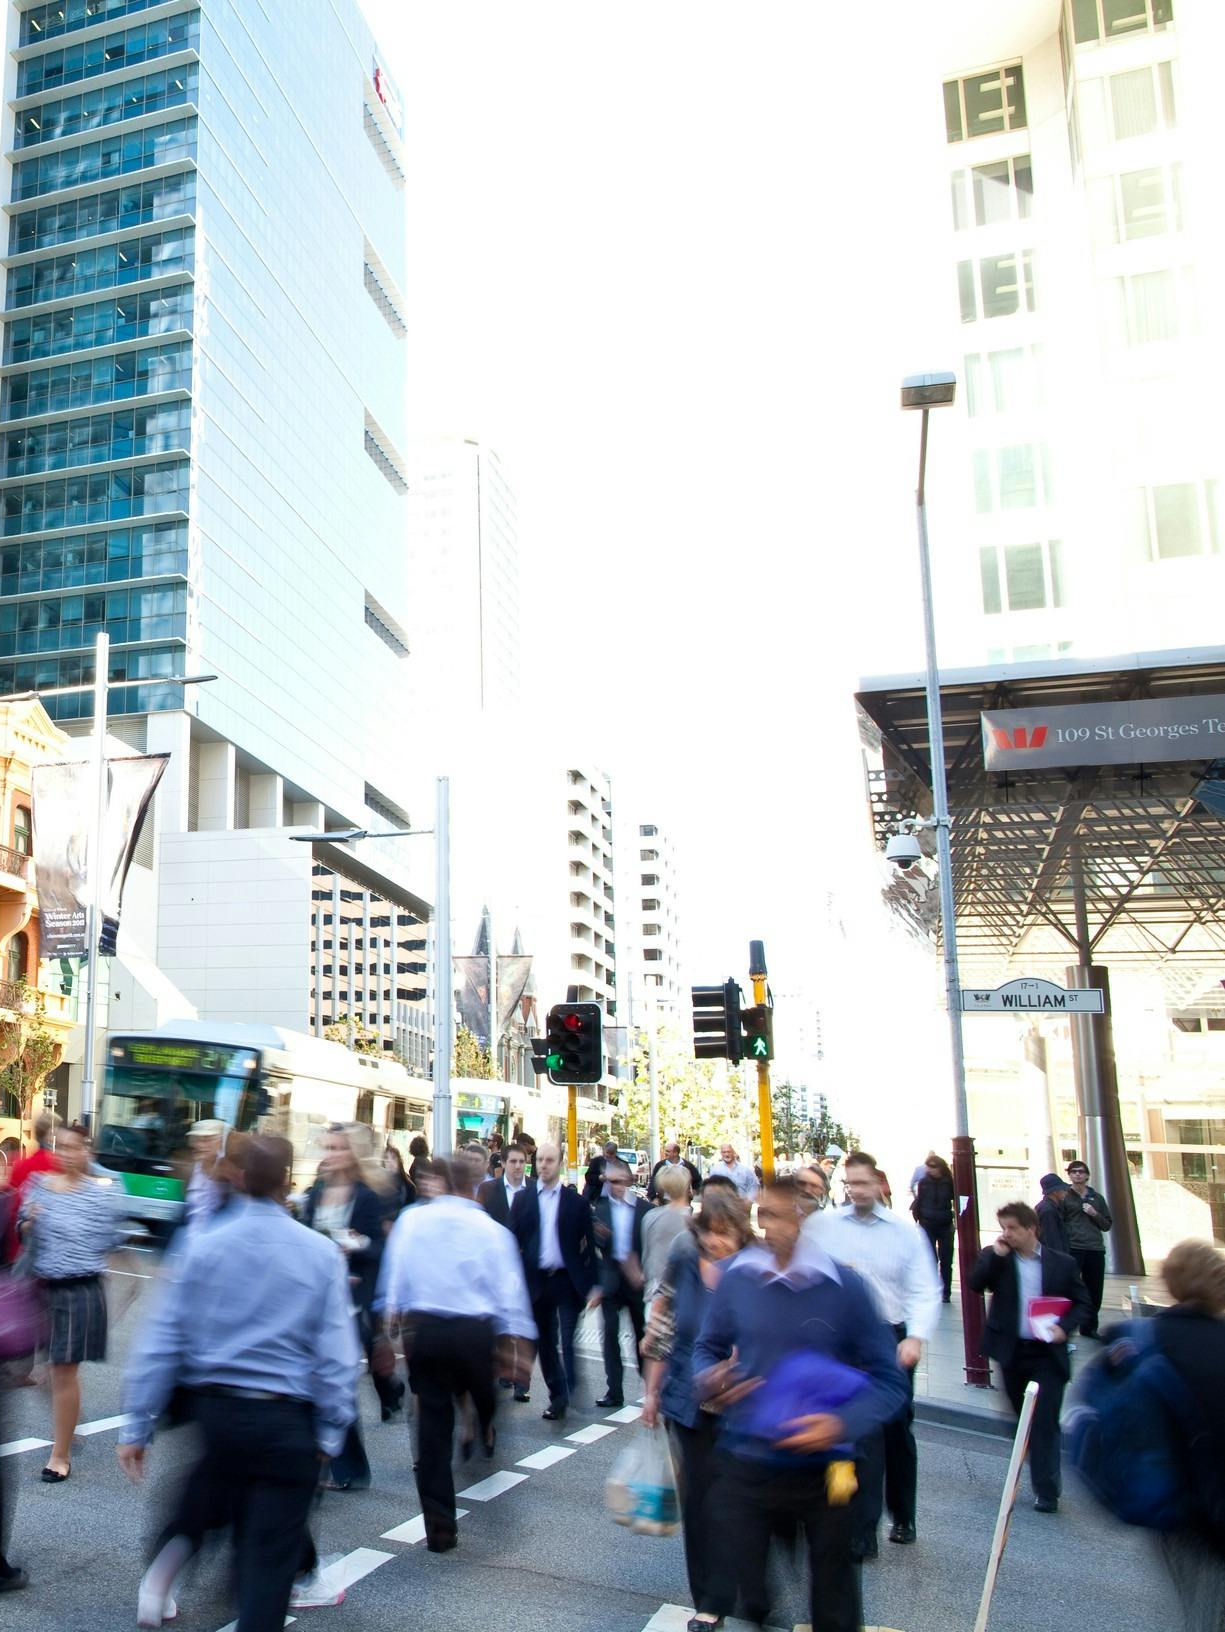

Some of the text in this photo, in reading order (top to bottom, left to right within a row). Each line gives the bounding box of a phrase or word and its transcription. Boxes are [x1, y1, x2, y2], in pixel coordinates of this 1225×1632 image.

[1056, 727, 1090, 743] 109
[1094, 725, 1115, 741] St
[1119, 723, 1199, 740] Georges
[44, 912, 71, 920] Winter
[1001, 994, 1066, 1008] WILLIAM
[1068, 994, 1079, 1002] ST
